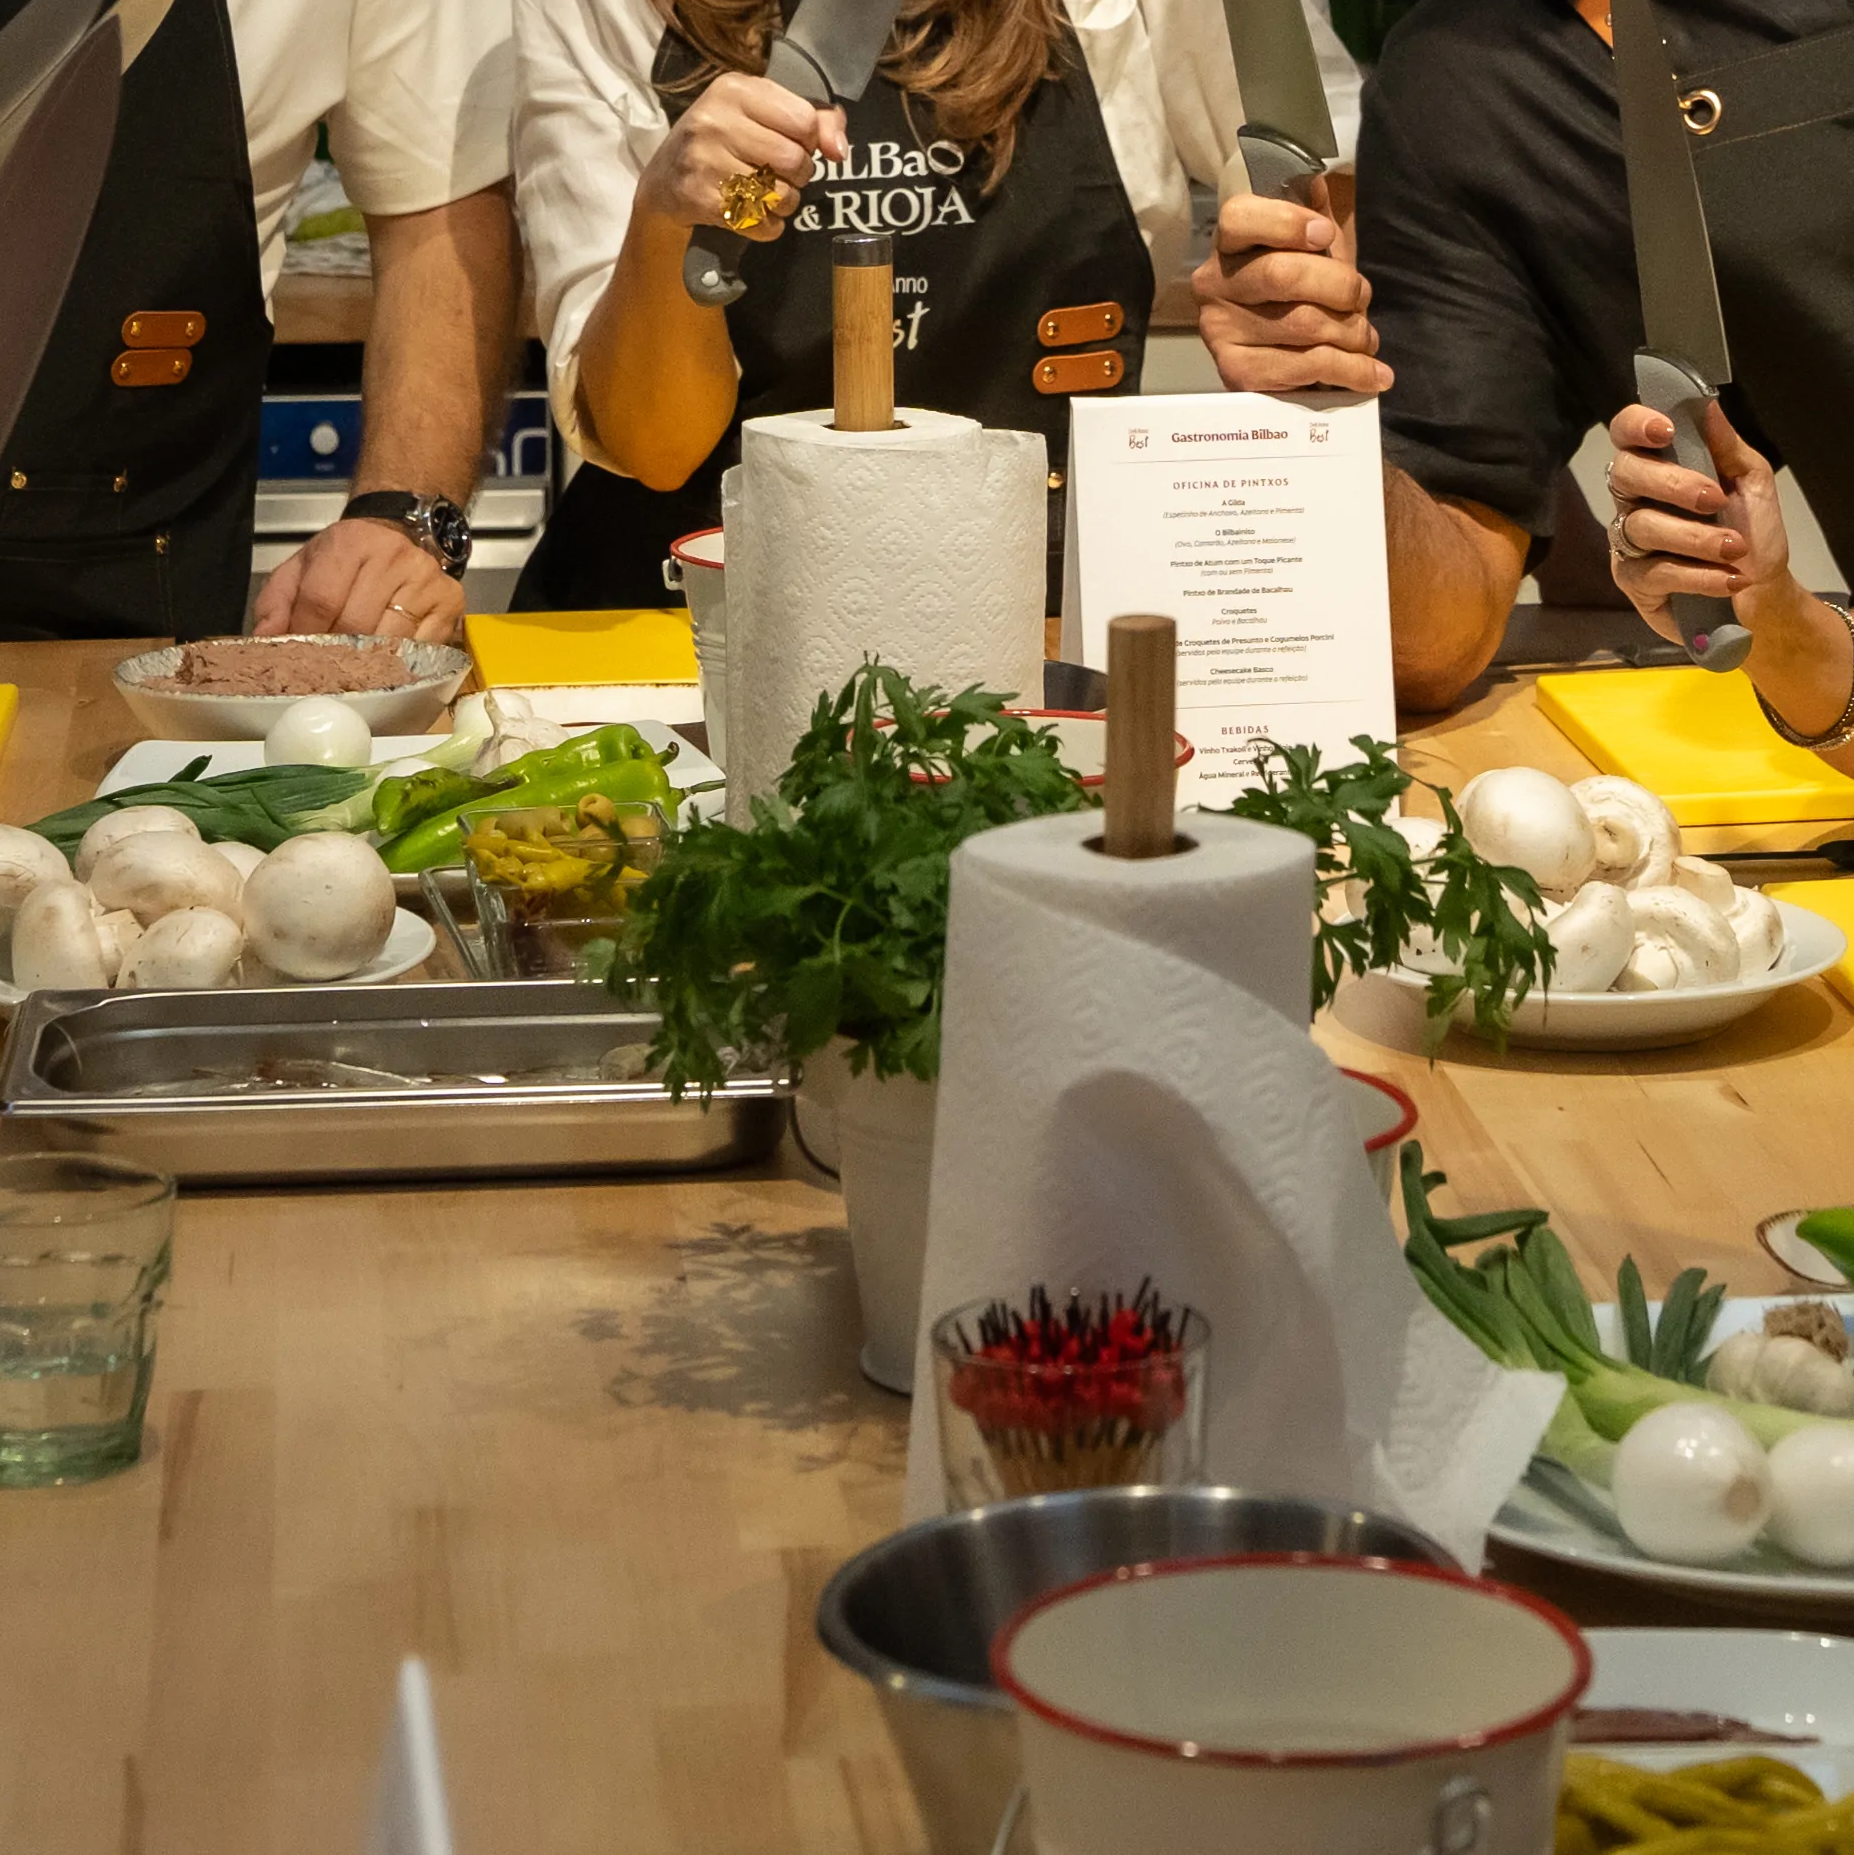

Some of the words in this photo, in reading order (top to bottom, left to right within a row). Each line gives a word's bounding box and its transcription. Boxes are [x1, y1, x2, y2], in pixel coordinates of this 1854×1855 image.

[793, 204, 823, 232] &
[825, 185, 976, 236] RIOJA
[893, 276, 928, 295] nno
[1171, 431, 1250, 444] Gastronomia
[1251, 428, 1289, 441] Bilbao
[1173, 480, 1220, 491] OFICINA
[1223, 479, 1237, 489] DE
[1241, 477, 1290, 488] PINTXOS
[1215, 529, 1221, 537] O
[1194, 559, 1203, 567] de
[1205, 559, 1224, 567] Atum
[1224, 558, 1240, 566] com
[1254, 556, 1276, 566] Toque
[1276, 556, 1303, 564] Picante
[1207, 588, 1216, 597] de
[1217, 587, 1250, 596] Brandade
[1251, 587, 1260, 595] de
[1221, 607, 1258, 616] Croquetes
[1184, 637, 1221, 648] Croquetes
[1221, 637, 1231, 646] de
[1231, 636, 1264, 645] Presunto
[1310, 633, 1335, 642] Porcini
[1210, 666, 1252, 676] Cheesecake
[1221, 725, 1269, 735] BEBIDAS
[1199, 746, 1220, 755] Vinho
[1218, 770, 1245, 779] Mineral
